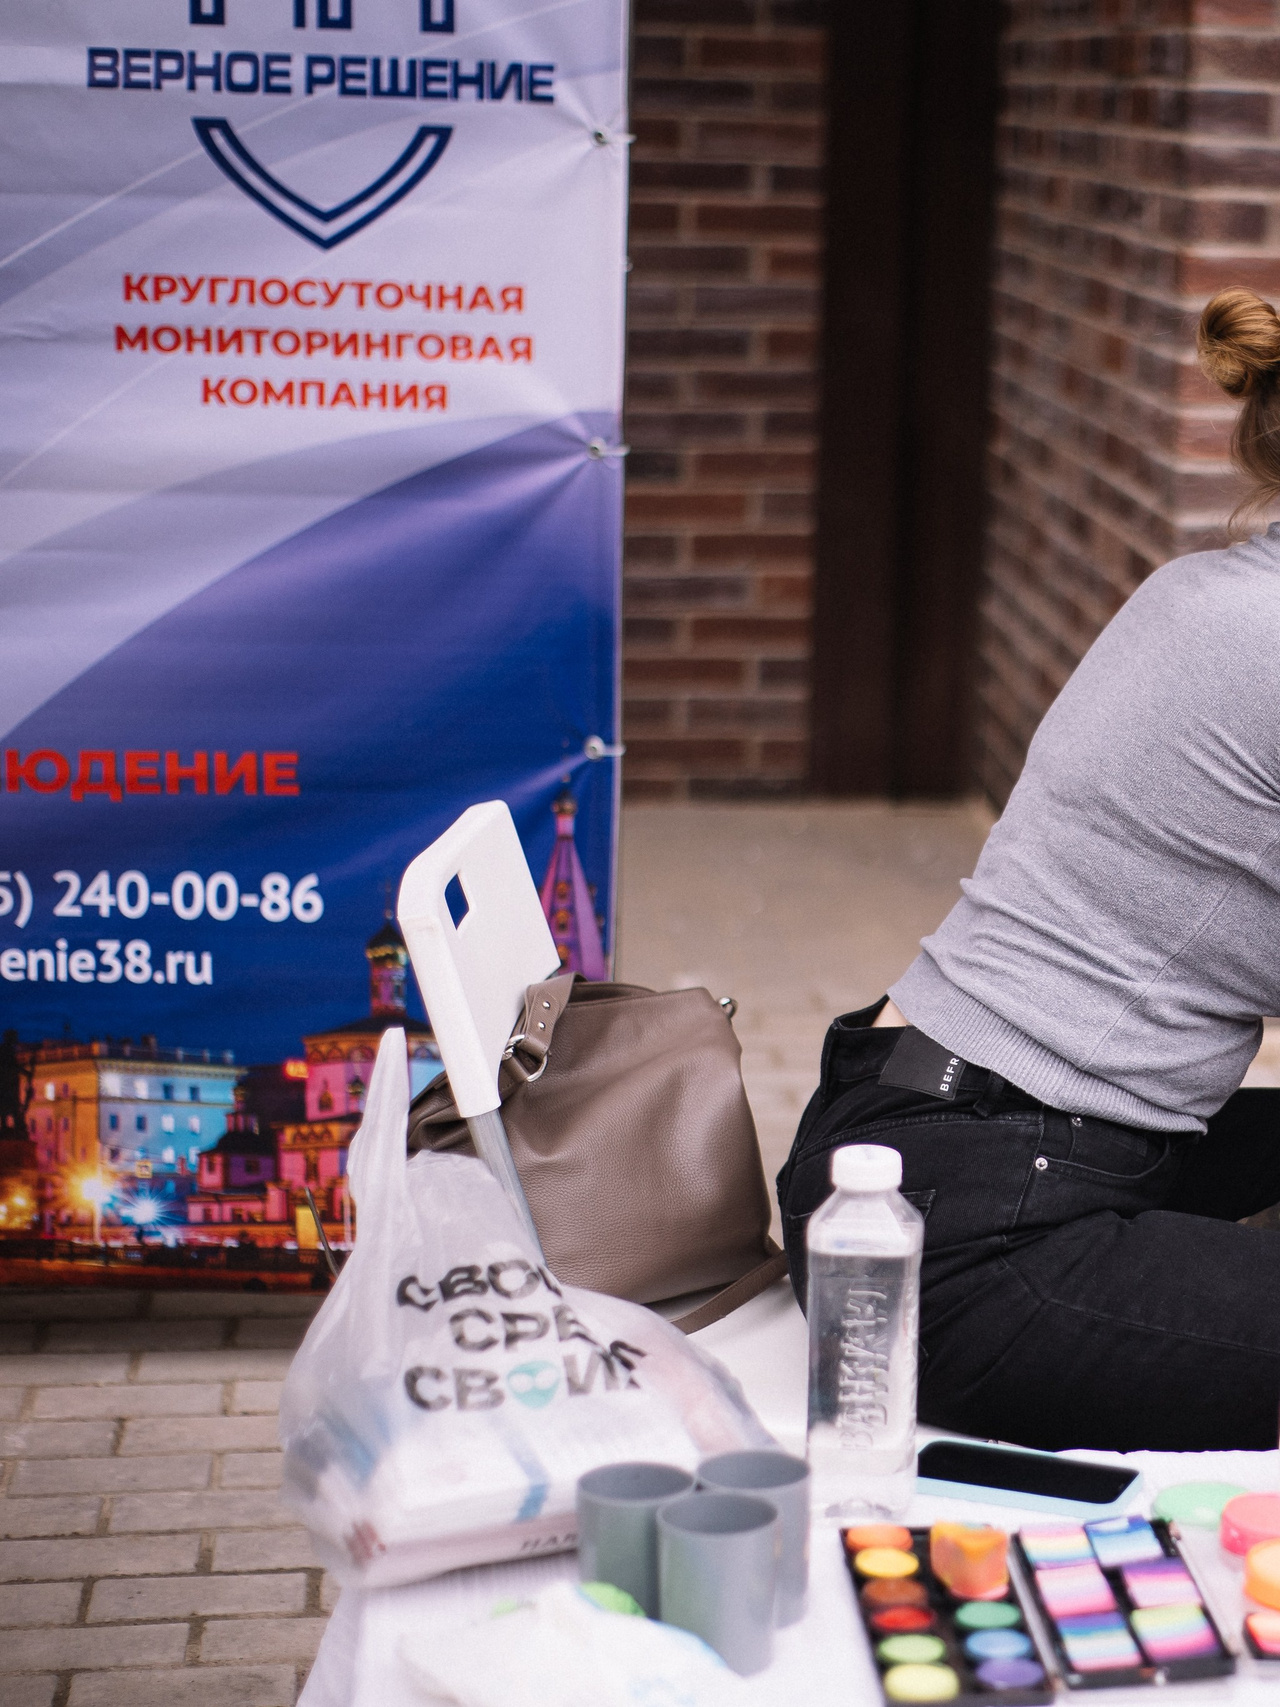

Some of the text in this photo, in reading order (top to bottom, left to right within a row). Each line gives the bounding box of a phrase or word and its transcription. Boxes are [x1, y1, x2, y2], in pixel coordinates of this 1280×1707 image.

[86, 47, 556, 104] ВЕРНОЕ РЕШЕНИЕ
[122, 273, 525, 314] КРУГЛОСУТОЧНАЯ
[114, 325, 534, 363] МОНИТОРИНГОВАЯ
[202, 378, 448, 412] КОМПАНИЯ
[4, 748, 300, 802] ЮДЕНИЕ
[53, 869, 325, 923] 240-00-86
[0, 938, 213, 986] enie38.ru
[939, 1057, 960, 1092] BEFR
